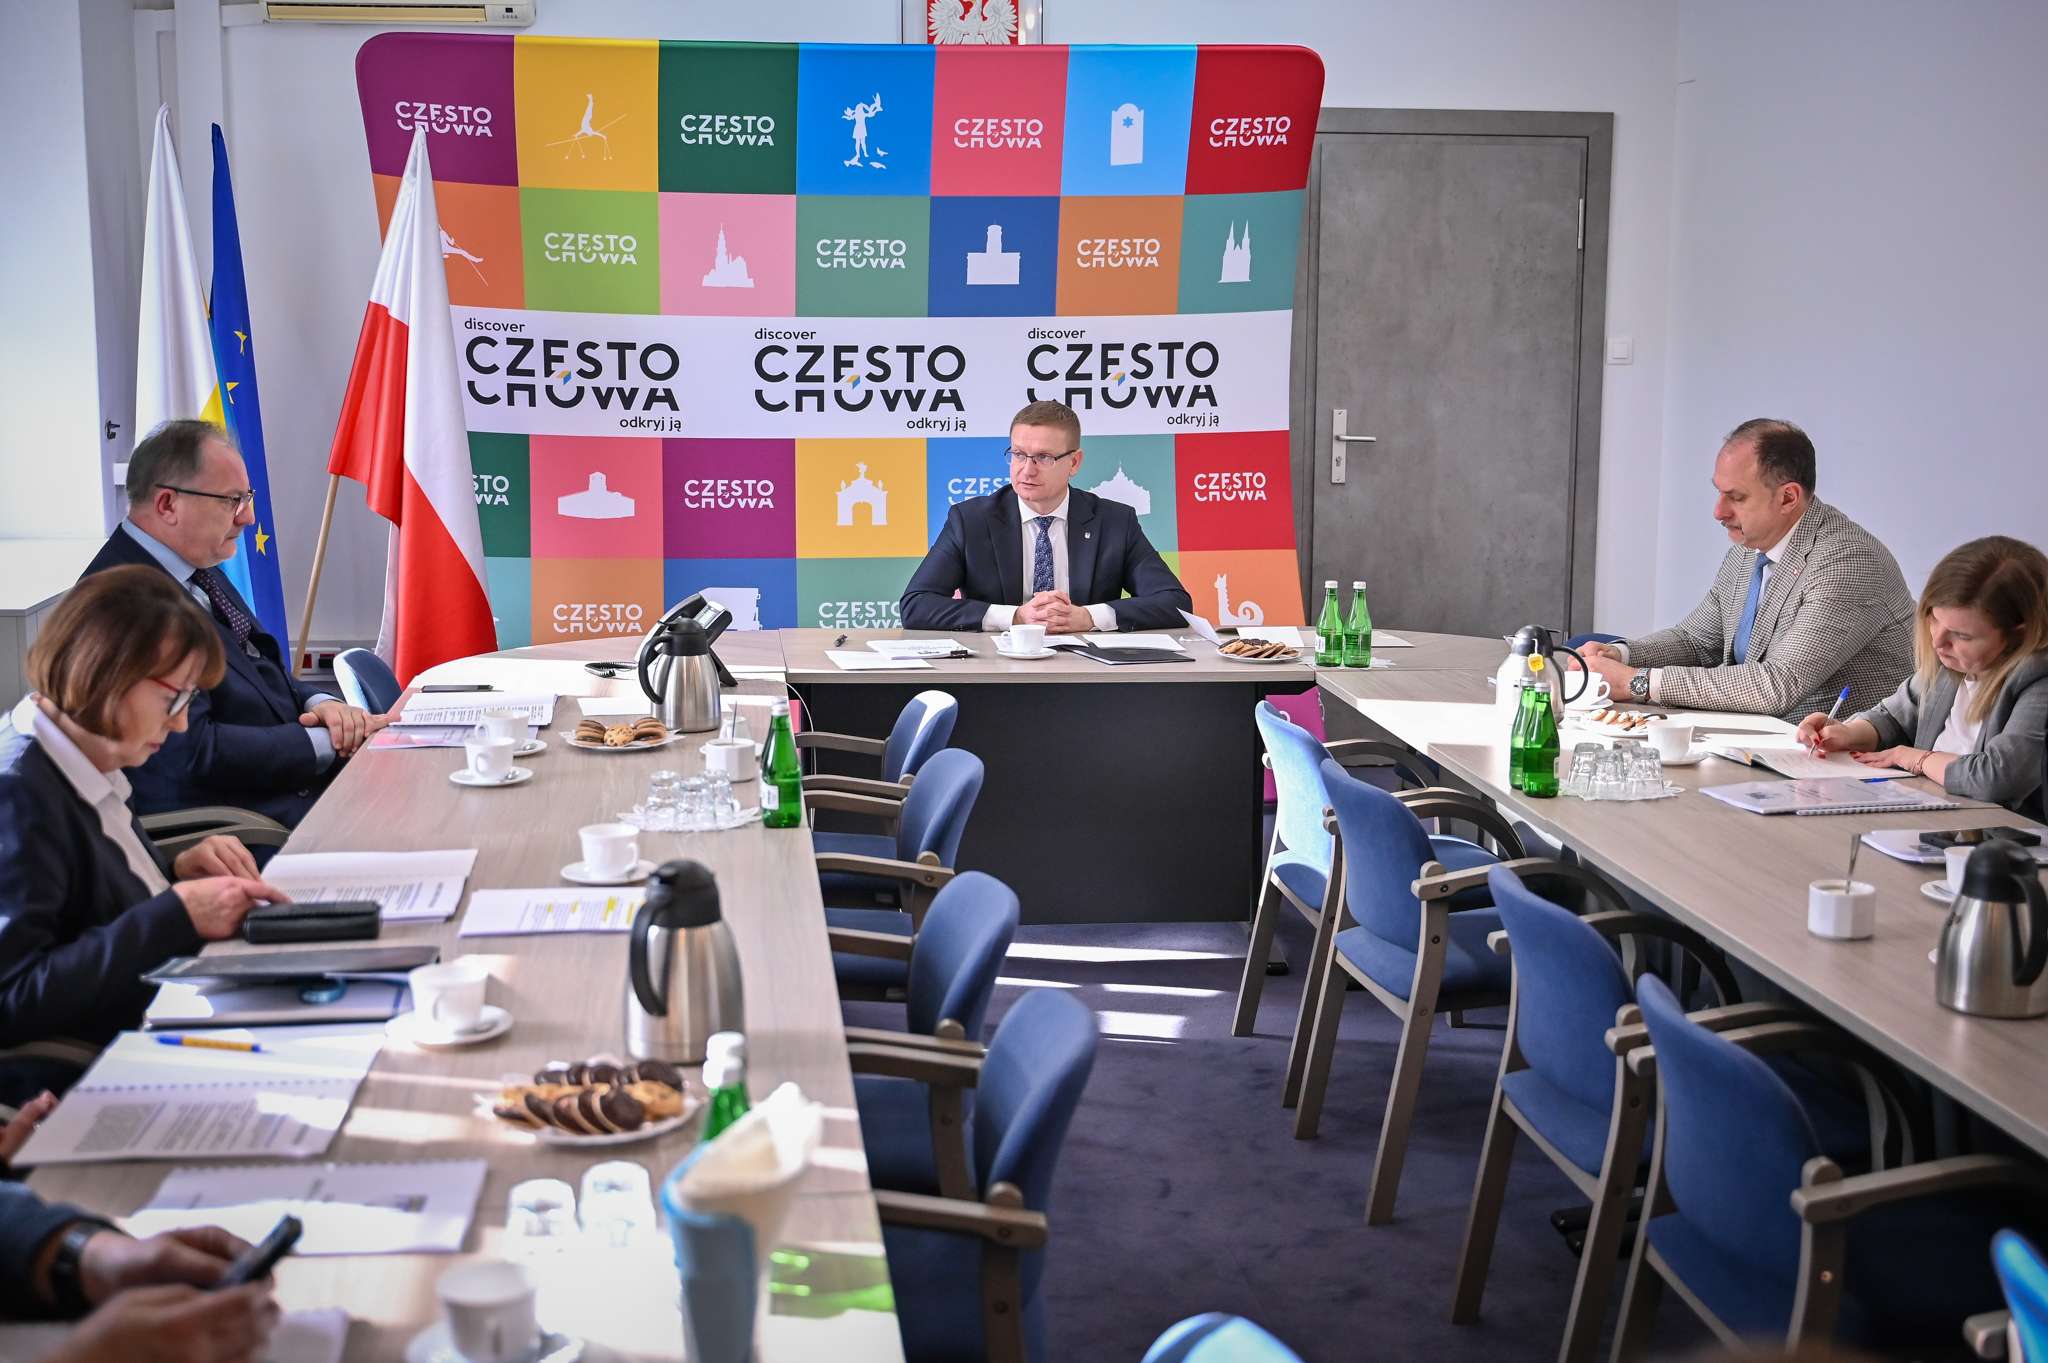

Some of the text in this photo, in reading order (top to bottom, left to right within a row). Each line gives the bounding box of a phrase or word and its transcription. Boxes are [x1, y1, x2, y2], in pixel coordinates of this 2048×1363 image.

[464, 318, 525, 333] discover
[754, 328, 816, 340] discover
[1027, 328, 1086, 339] discover
[468, 381, 680, 411] CHOWA
[755, 389, 966, 412] CHOWA
[620, 416, 682, 432] odkryj ją
[906, 417, 967, 432] odkryj ją
[1167, 413, 1220, 427] odkryj ją
